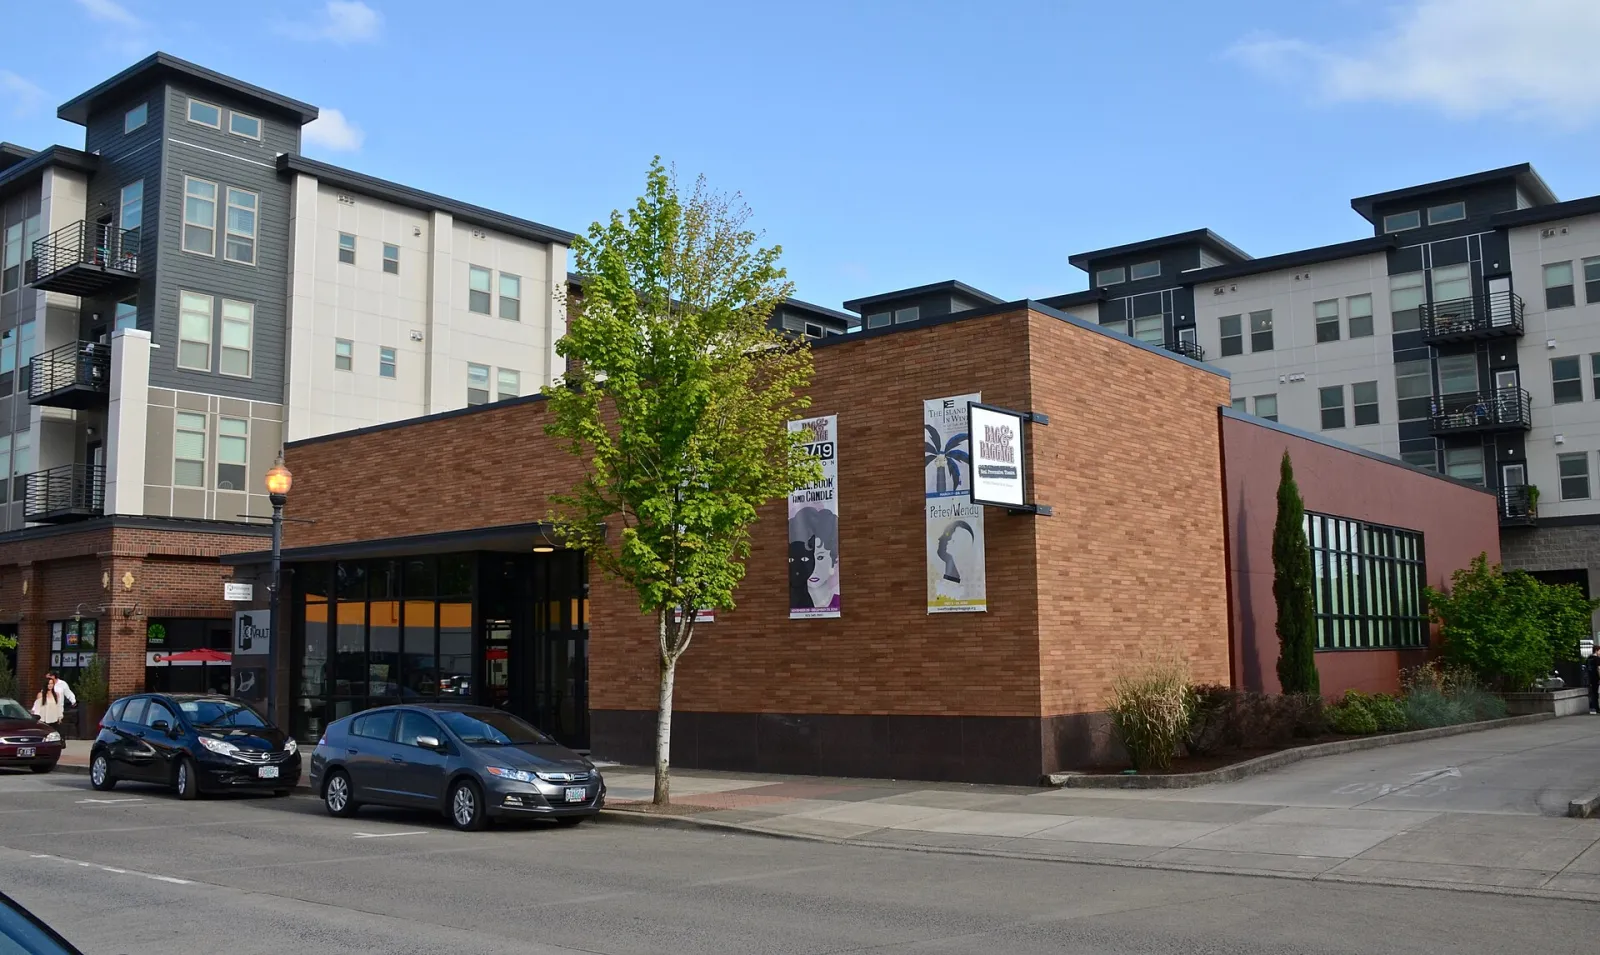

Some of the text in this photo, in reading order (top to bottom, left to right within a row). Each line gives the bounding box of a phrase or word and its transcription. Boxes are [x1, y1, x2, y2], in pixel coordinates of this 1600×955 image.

[984, 425, 1000, 444] BAG
[979, 440, 1014, 464] BAGGAGE
[805, 490, 833, 502] CANDLE
